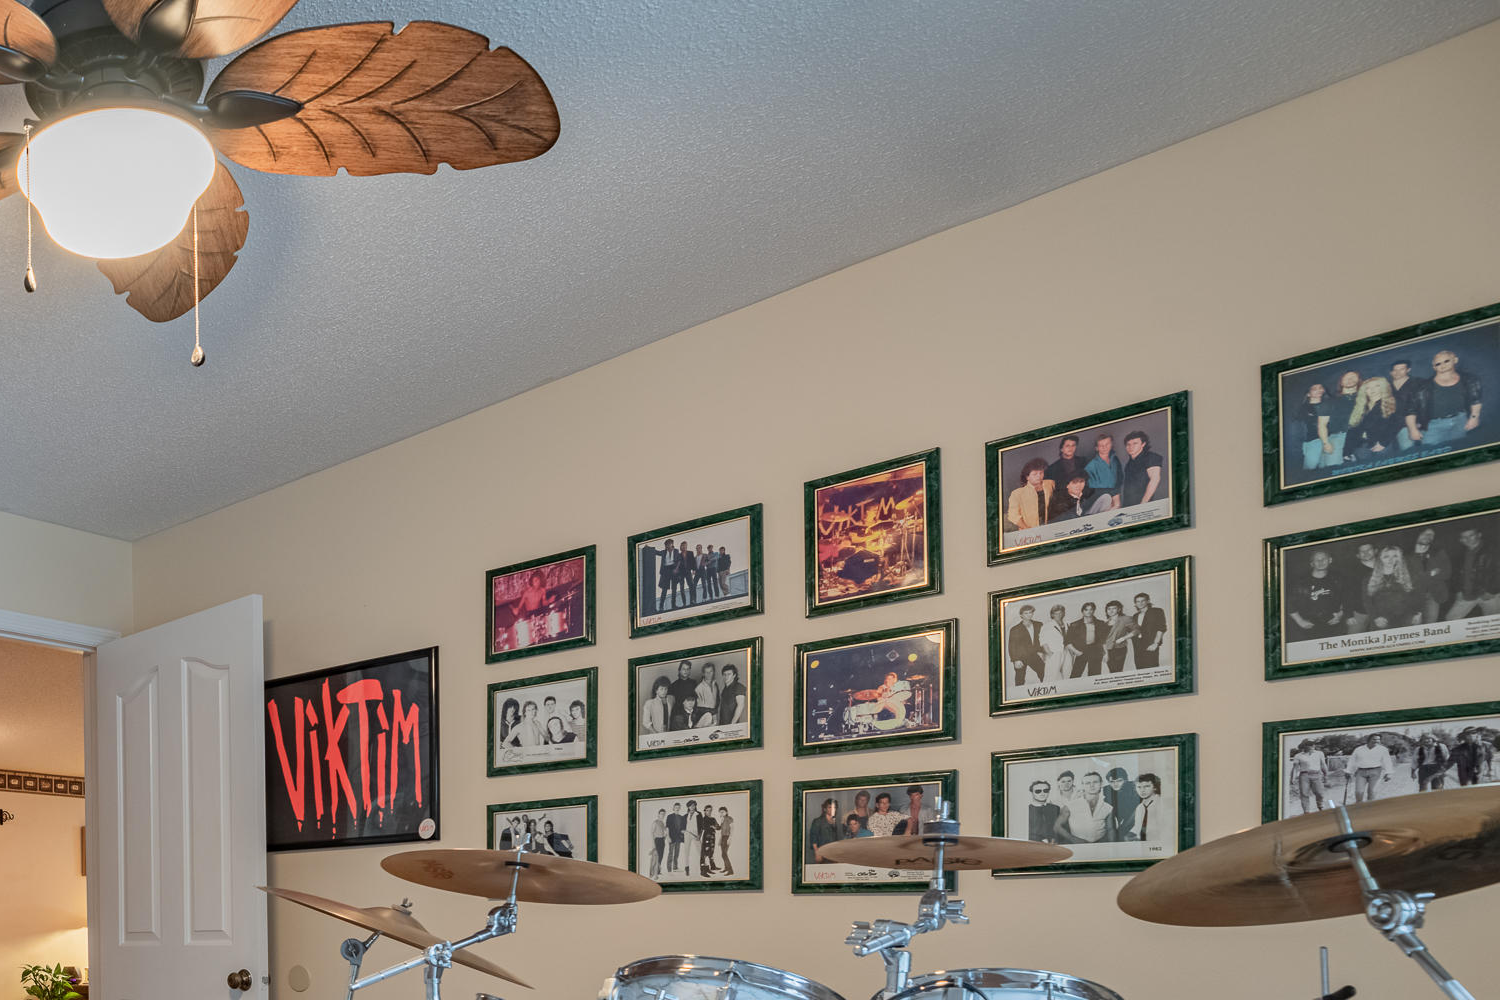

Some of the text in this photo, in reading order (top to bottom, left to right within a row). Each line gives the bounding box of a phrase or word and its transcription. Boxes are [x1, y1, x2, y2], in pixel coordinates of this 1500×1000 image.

[1319, 642, 1338, 650] The
[1341, 635, 1380, 648] Monika
[1382, 631, 1420, 644] Jaymes
[1423, 625, 1451, 636] Band
